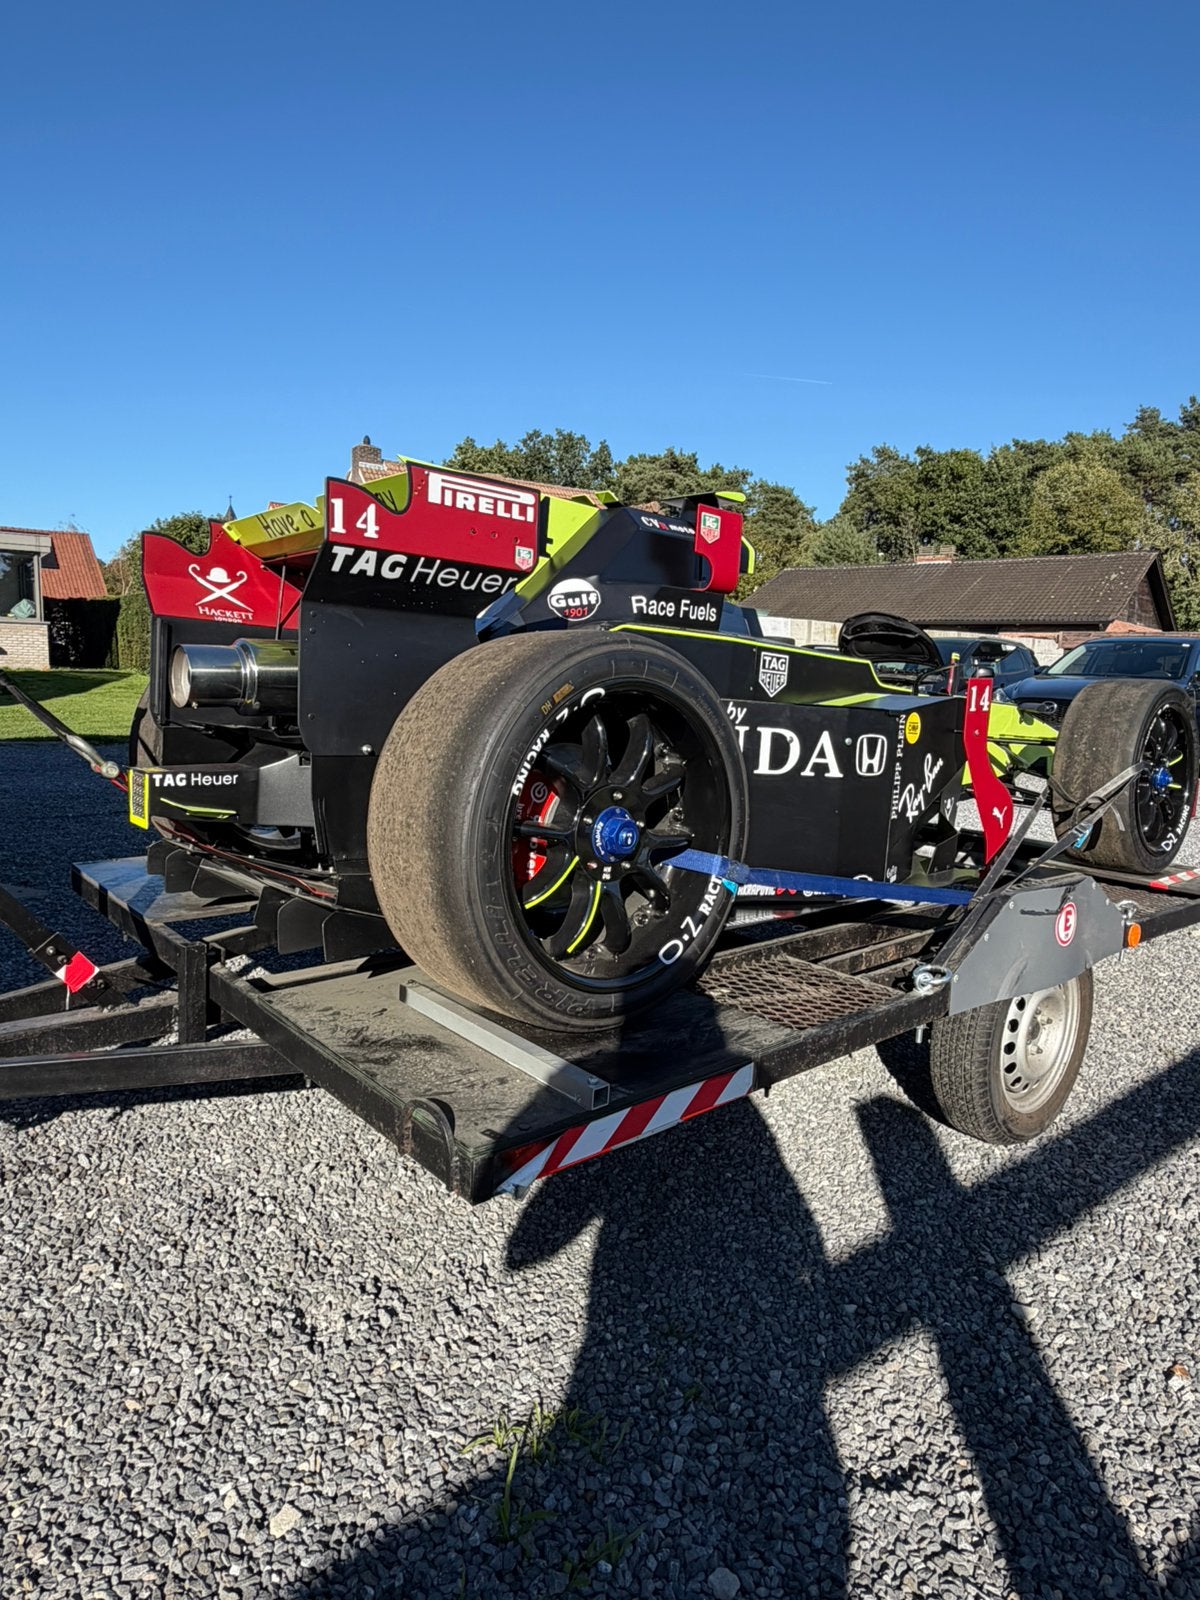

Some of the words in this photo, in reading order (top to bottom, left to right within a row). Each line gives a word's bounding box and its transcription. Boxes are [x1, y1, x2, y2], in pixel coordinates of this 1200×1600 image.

[428, 472, 536, 522] PIRELLI
[256, 513, 300, 539] Have
[300, 508, 315, 528] a
[331, 498, 379, 539] 14
[331, 545, 408, 580] TAG
[410, 557, 518, 595] Heuer
[198, 606, 254, 620] HACKETT
[551, 592, 597, 608] Gulf
[564, 607, 588, 618] 1901
[631, 595, 675, 618] Race
[679, 600, 717, 622] Fuels
[763, 656, 786, 671] TAG
[760, 672, 786, 693] HEUER
[969, 685, 990, 712] 14
[727, 701, 747, 724] by
[896, 714, 906, 758] PLEIN
[511, 728, 550, 796] RACING
[152, 773, 187, 787] TAG
[190, 773, 239, 786] Heuer
[891, 762, 902, 820] PHILIPP
[899, 753, 944, 824] Ray-Ban
